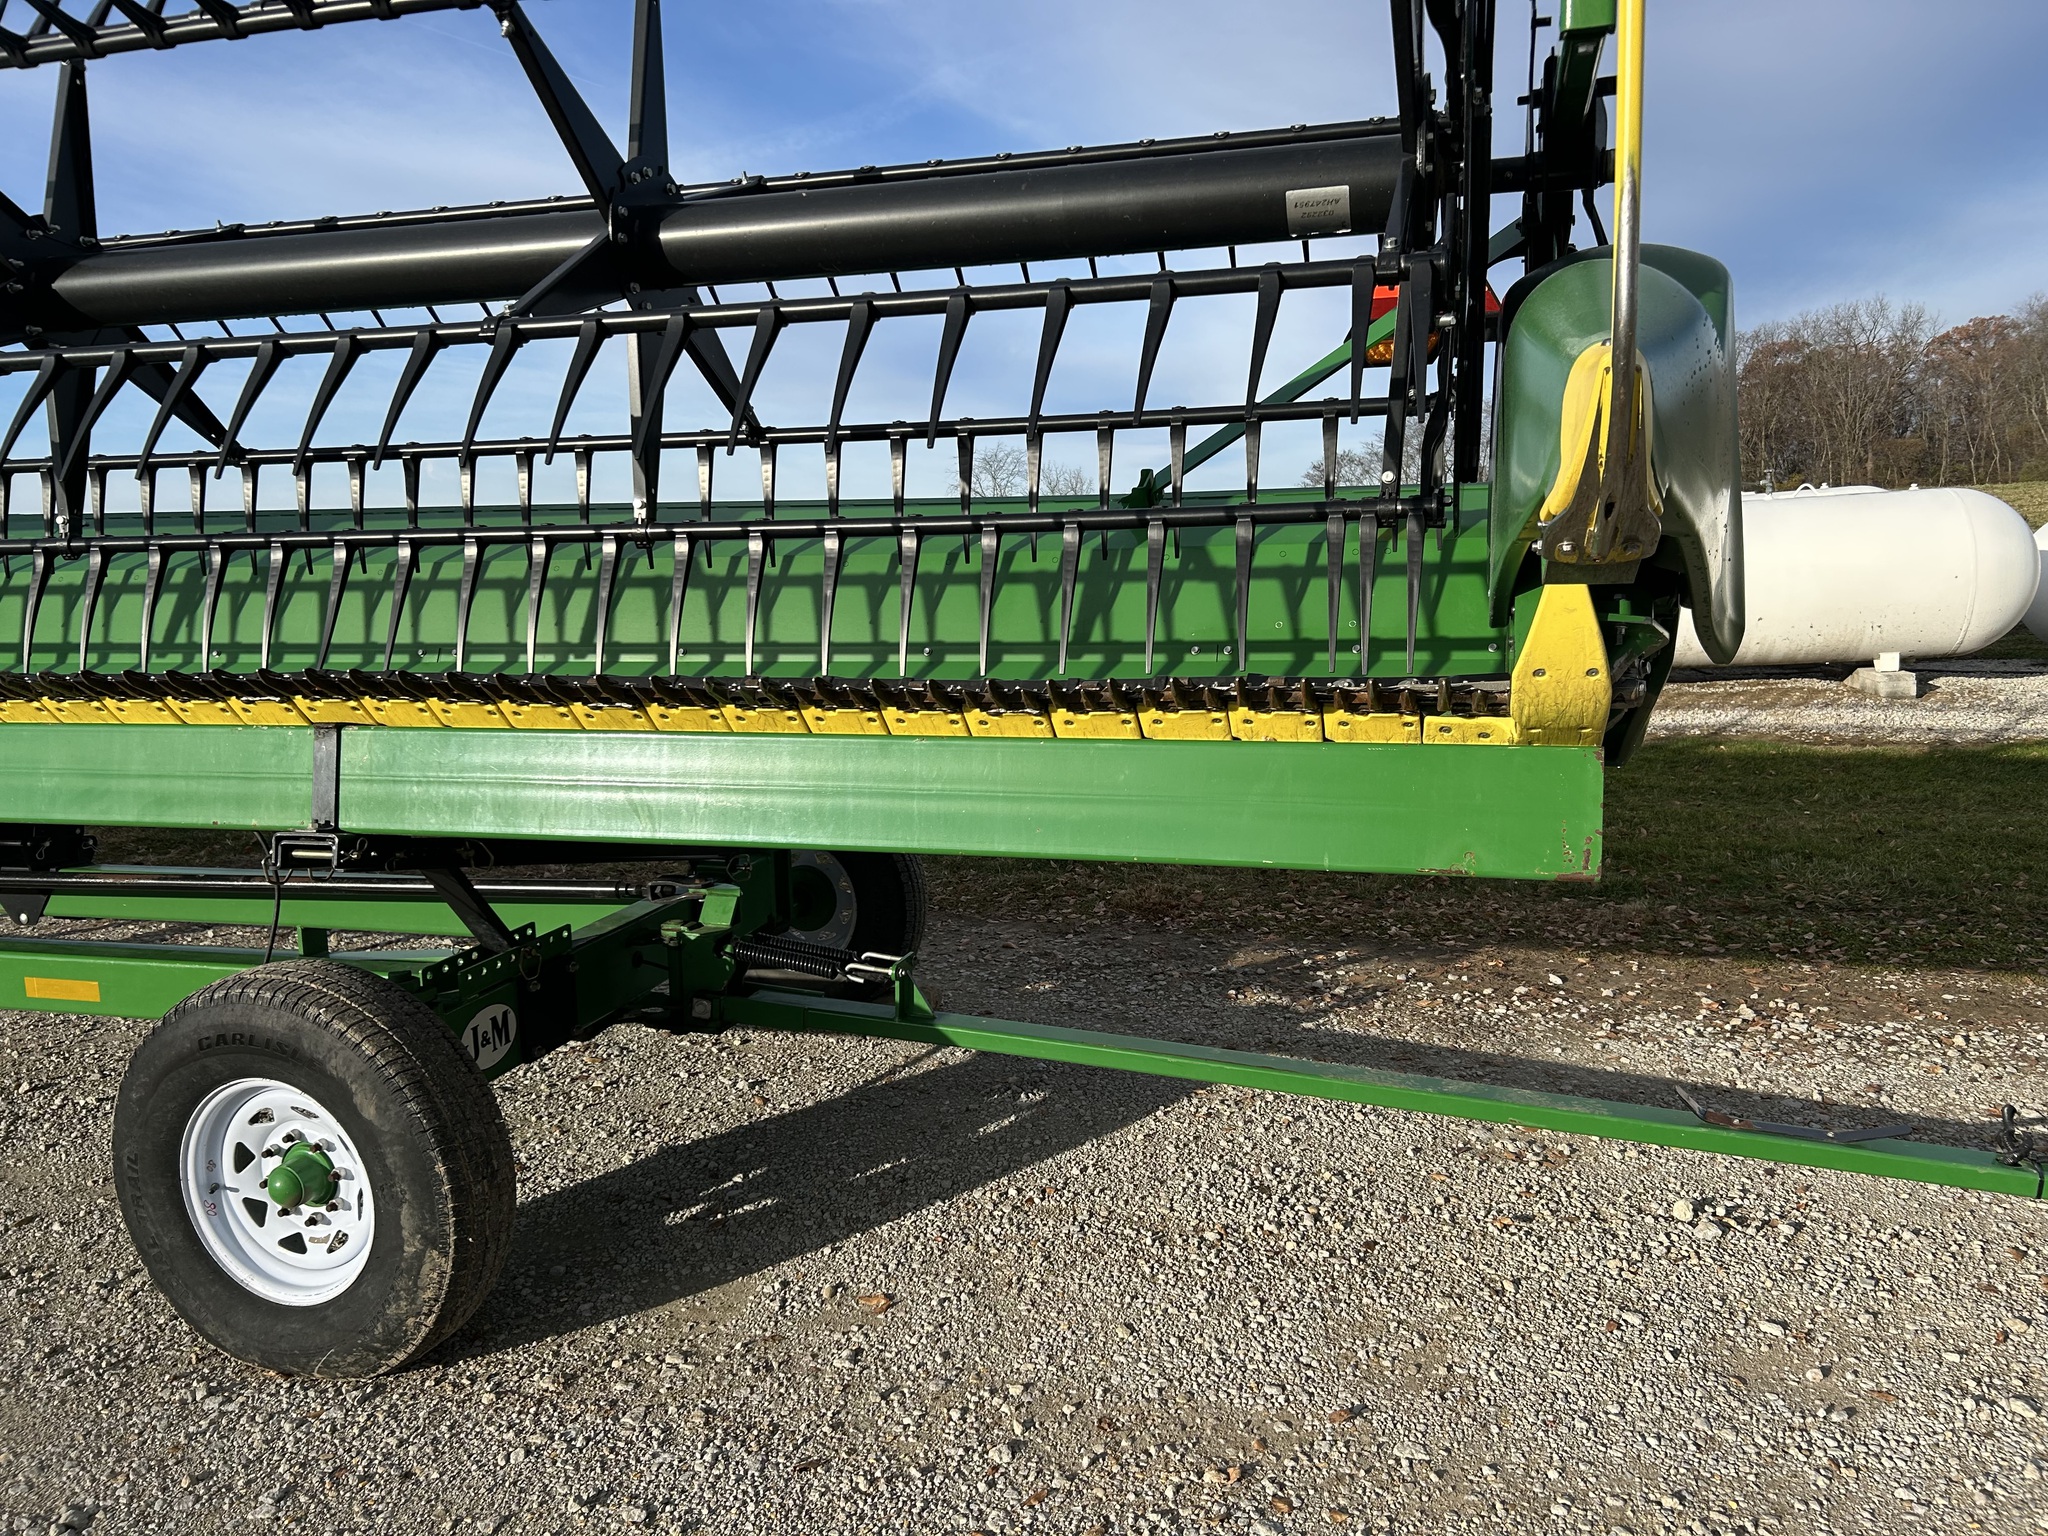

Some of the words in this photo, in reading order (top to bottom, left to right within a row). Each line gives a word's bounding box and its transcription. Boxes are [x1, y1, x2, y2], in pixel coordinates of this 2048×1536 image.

[197, 1032, 323, 1072] CARLISLE
[465, 1008, 511, 1062] J&M
[126, 1152, 147, 1225] TRAIL
